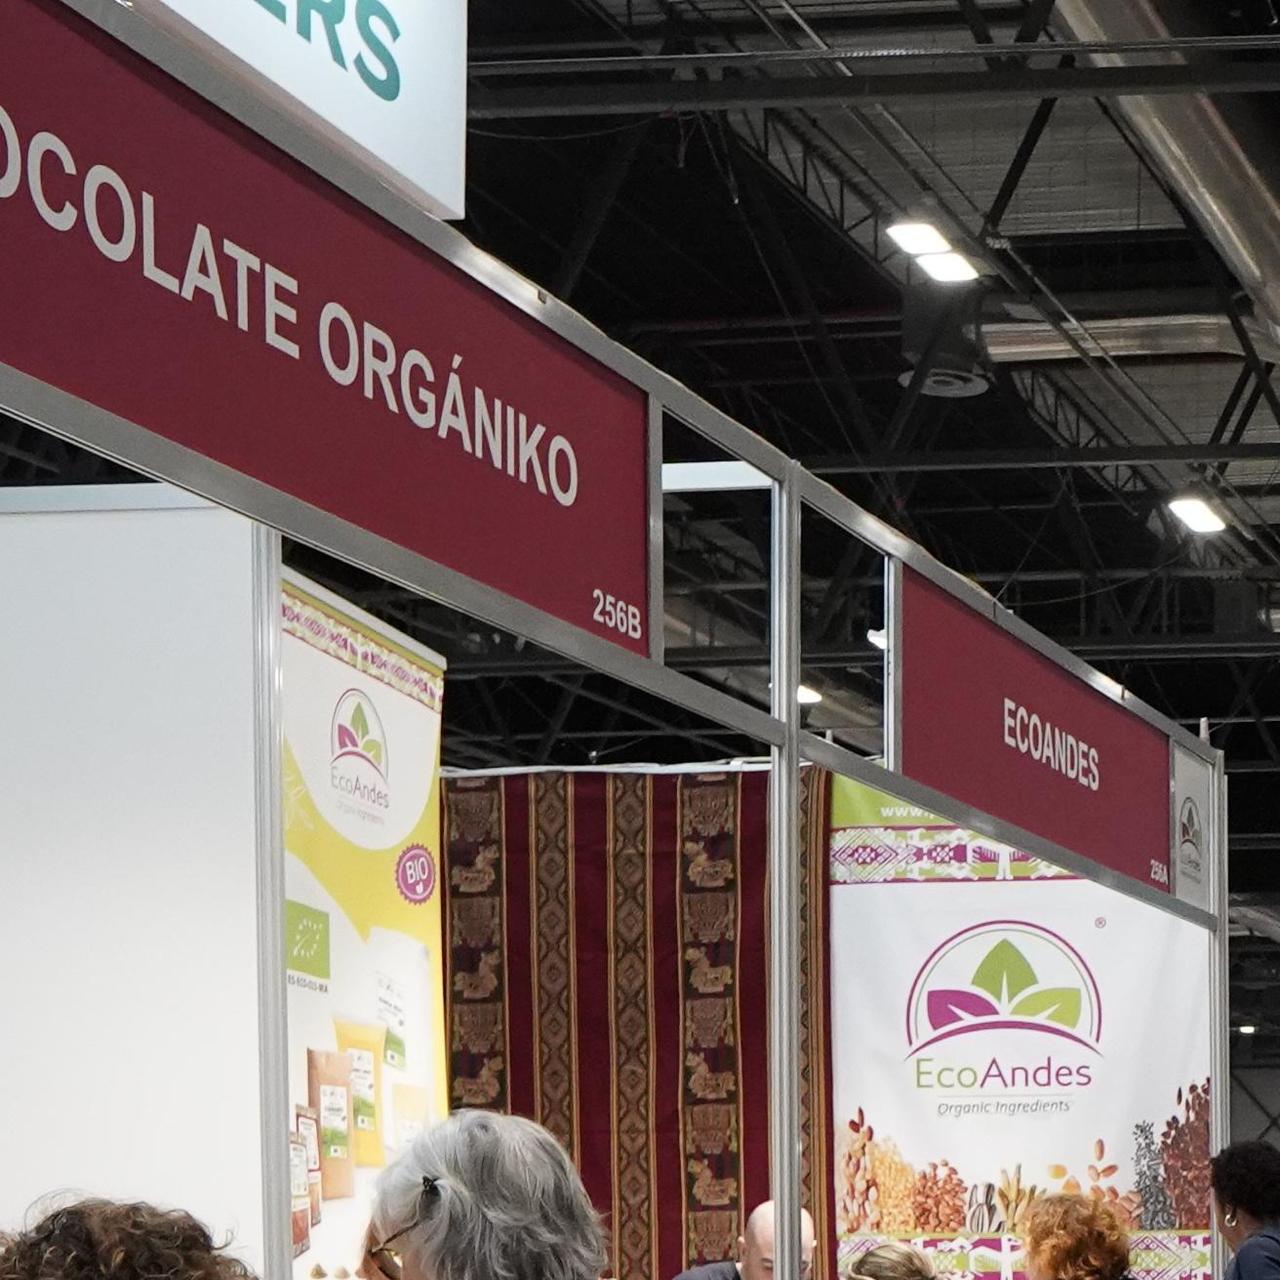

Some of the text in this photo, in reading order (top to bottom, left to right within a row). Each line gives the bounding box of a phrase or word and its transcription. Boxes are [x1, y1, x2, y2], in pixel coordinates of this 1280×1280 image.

[254, 0, 401, 102] RS
[319, 302, 579, 506] ORGÁNIKO
[592, 588, 643, 640] 256B
[1003, 698, 1100, 791] ECOANDES
[331, 766, 391, 809] EcoAndes
[405, 856, 429, 885] BIO
[915, 1056, 1092, 1088] EcoAndes
[937, 1100, 1071, 1118] Organic Ingredients
